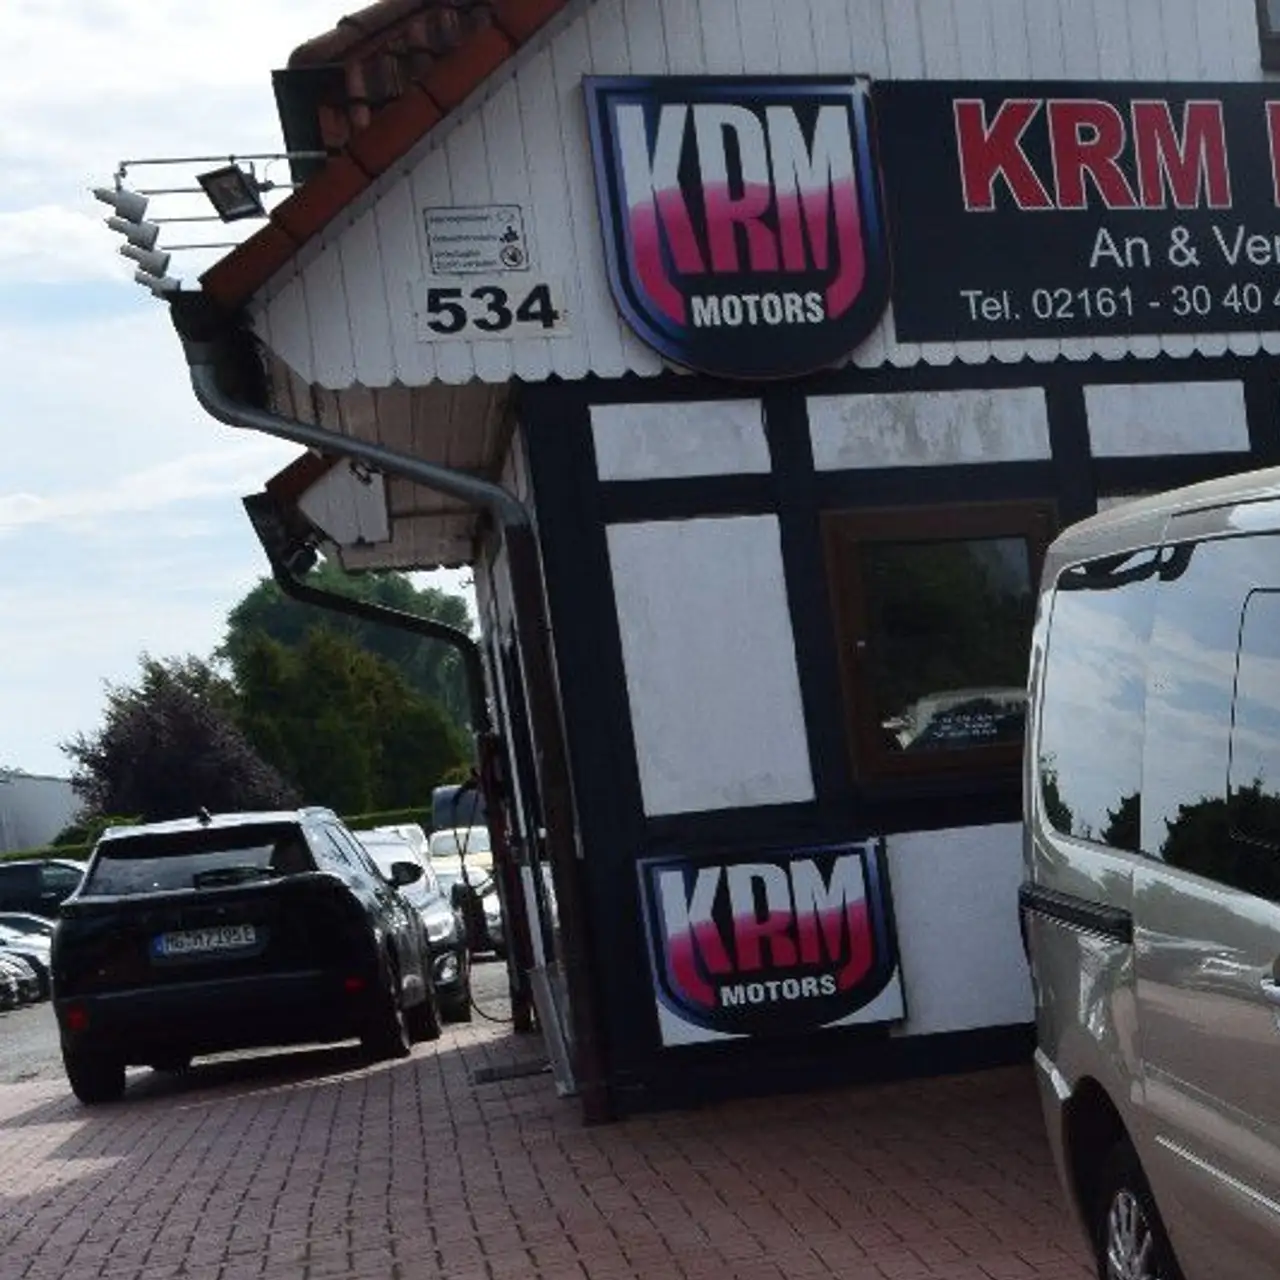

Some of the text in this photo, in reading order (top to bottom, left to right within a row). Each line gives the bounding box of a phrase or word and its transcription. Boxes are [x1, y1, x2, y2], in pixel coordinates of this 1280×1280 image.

[953, 98, 1232, 212] KRM
[614, 104, 866, 325] KRM
[1090, 228, 1150, 268] An
[1168, 228, 1200, 267] &
[427, 283, 559, 334] 534
[690, 291, 825, 327] MOTORS
[961, 289, 1020, 320] Tel.
[1032, 287, 1134, 319] 02161
[1173, 286, 1211, 315] 30
[1223, 284, 1261, 314] 40
[659, 854, 874, 1006] KRM
[720, 974, 837, 1007] MOTORS
